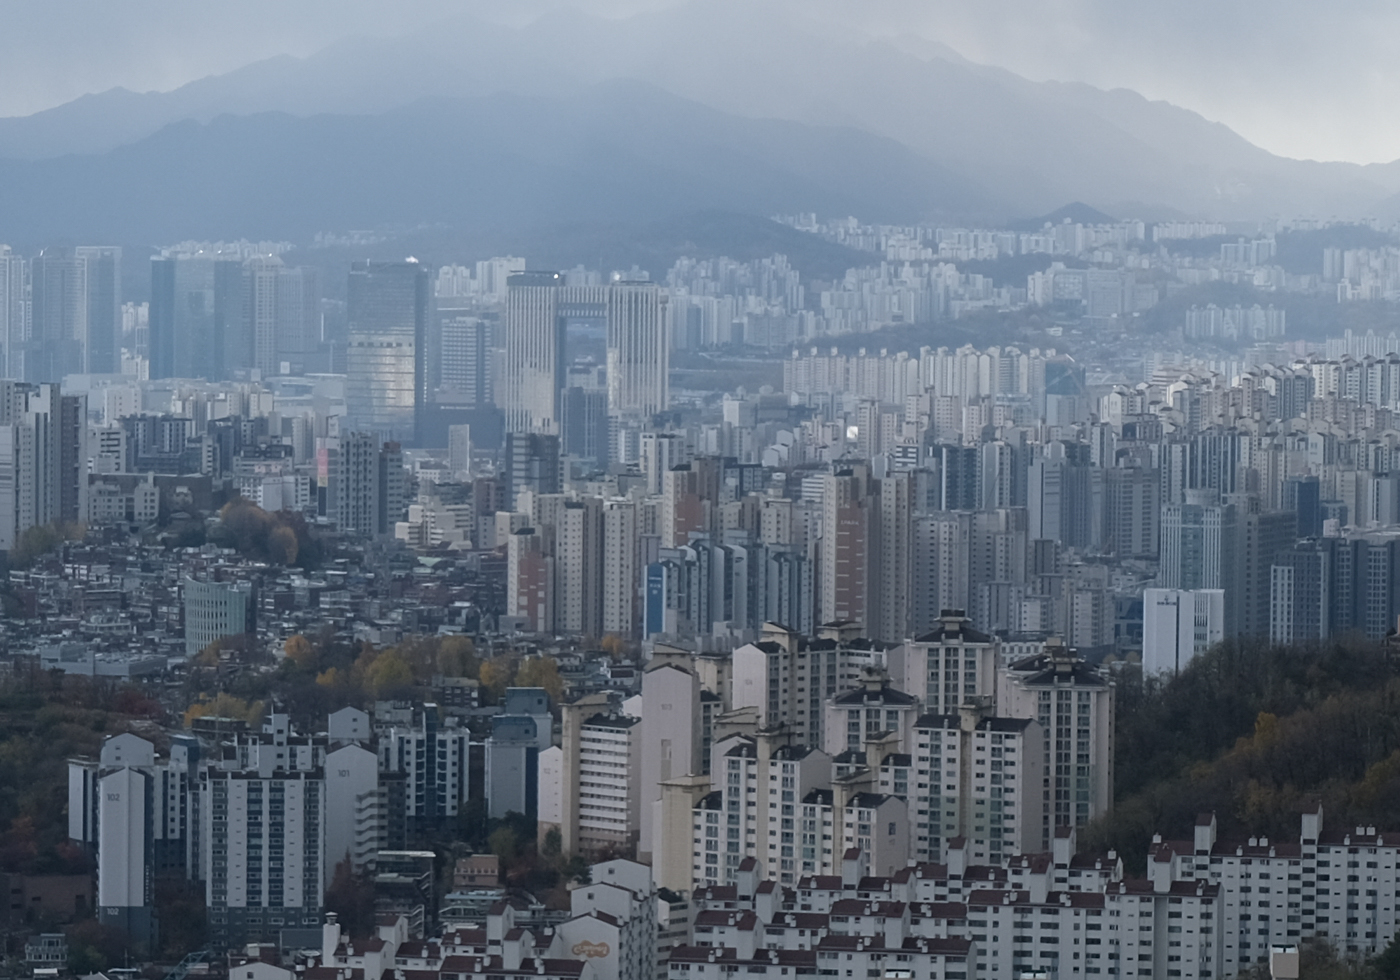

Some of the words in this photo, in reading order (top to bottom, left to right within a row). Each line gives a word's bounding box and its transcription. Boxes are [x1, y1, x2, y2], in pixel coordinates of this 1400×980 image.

[338, 769, 350, 778] 101
[107, 793, 121, 802] 102
[107, 907, 119, 916] 102
